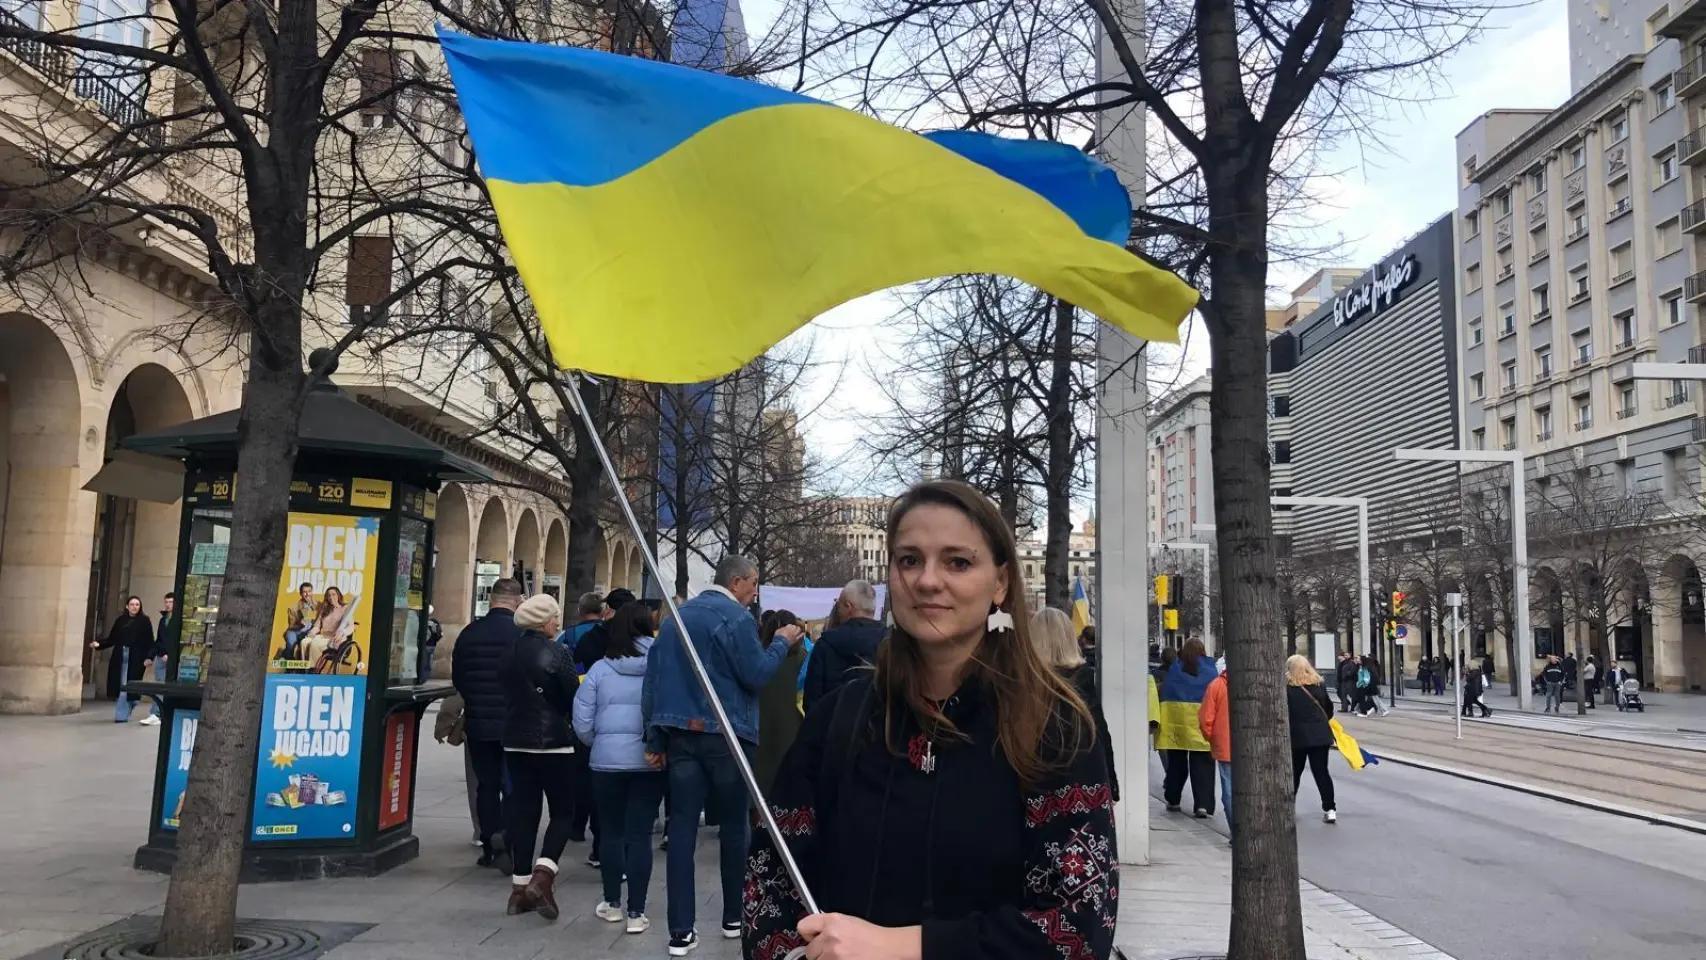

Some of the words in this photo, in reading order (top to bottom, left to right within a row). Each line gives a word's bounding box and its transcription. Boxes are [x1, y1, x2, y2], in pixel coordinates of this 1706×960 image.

[1333, 297, 1344, 327] El
[1345, 284, 1370, 318] Corte
[213, 483, 229, 496] 120
[319, 485, 345, 499] 120
[287, 524, 368, 570] BIEN
[286, 568, 364, 597] JUGADO
[274, 685, 355, 730] BIEN
[180, 718, 198, 750] BI
[272, 730, 350, 758] JUGADO
[274, 825, 295, 833] ONCE
